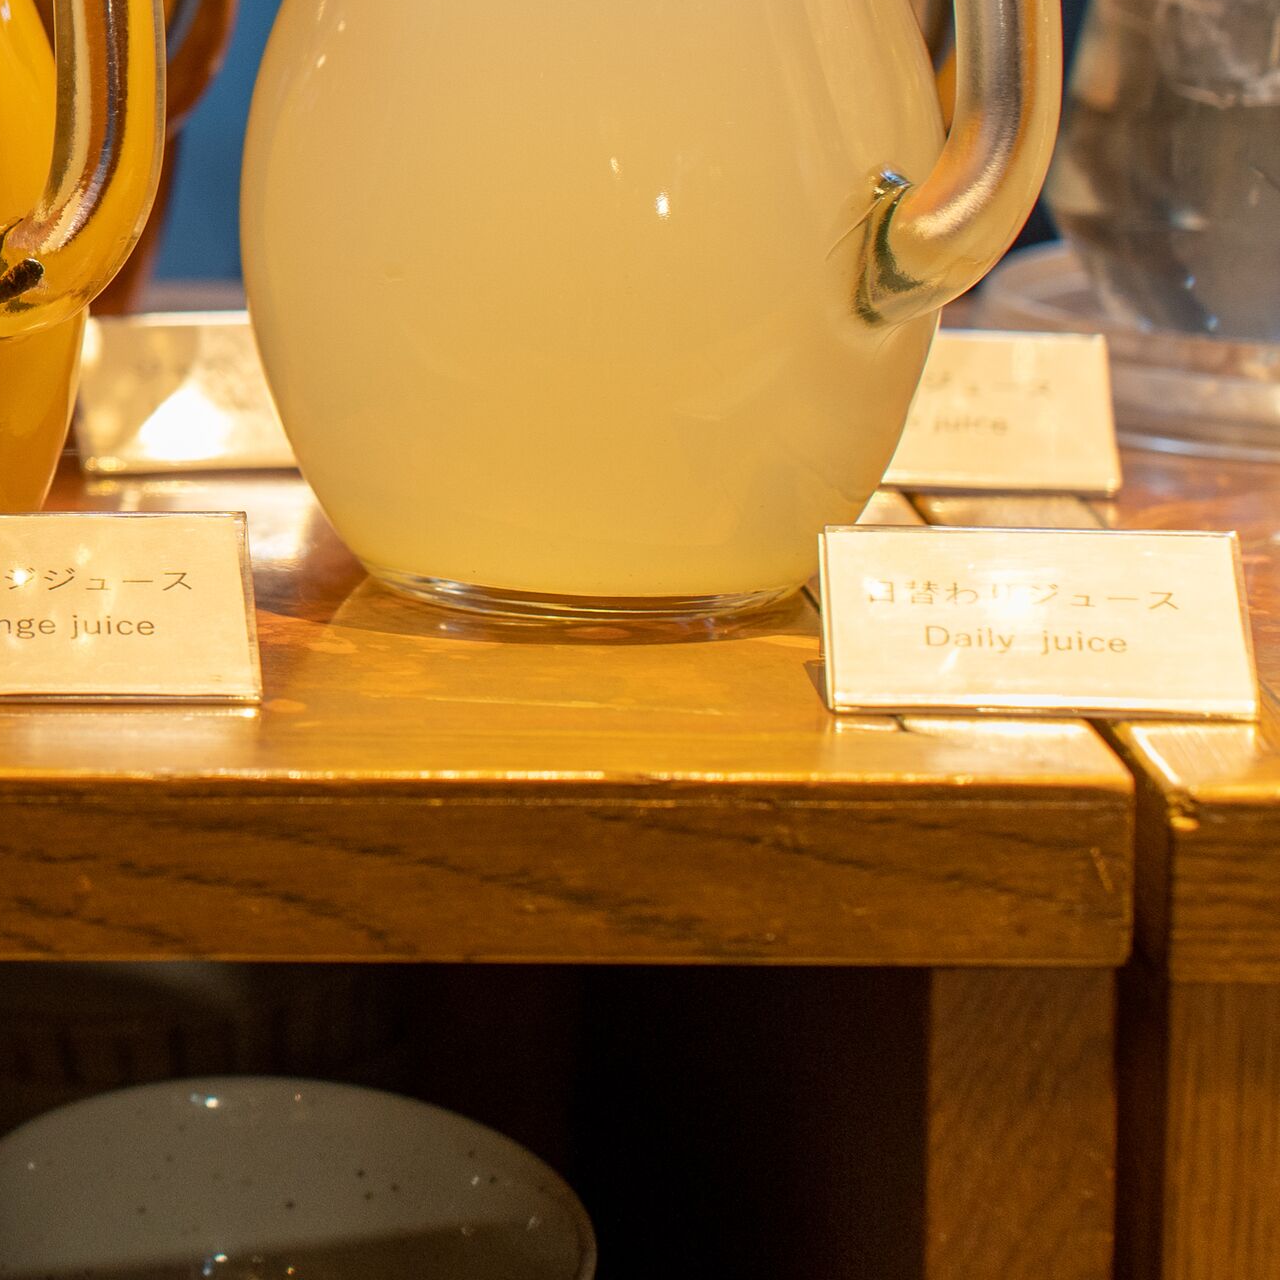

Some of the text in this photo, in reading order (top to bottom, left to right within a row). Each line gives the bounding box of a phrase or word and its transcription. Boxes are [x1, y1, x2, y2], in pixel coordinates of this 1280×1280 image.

[70, 614, 156, 641] juice
[924, 625, 1128, 655] Daily juice
